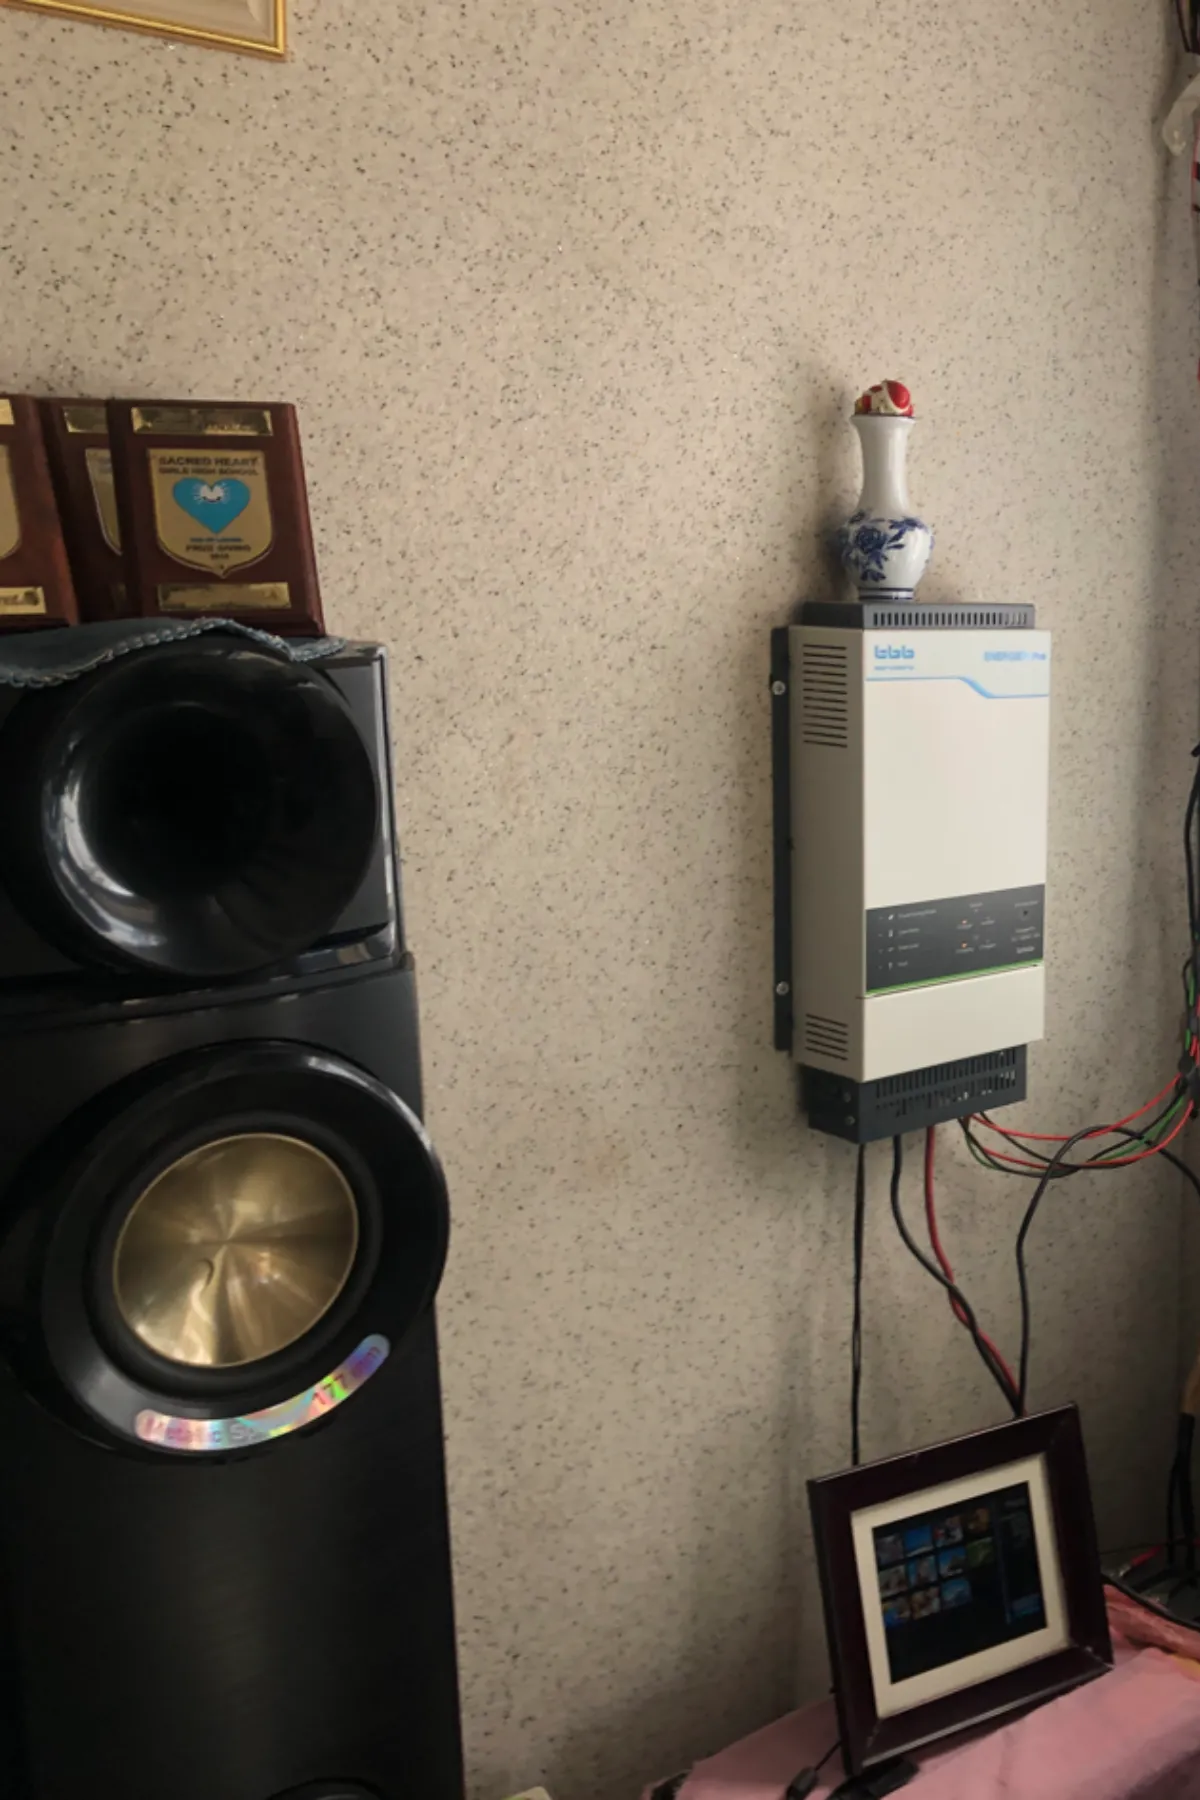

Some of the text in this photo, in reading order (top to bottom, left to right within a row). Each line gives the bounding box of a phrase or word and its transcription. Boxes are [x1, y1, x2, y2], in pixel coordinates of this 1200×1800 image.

[159, 456, 258, 465] SACRED HEART
[218, 468, 259, 476] SCHOOL
